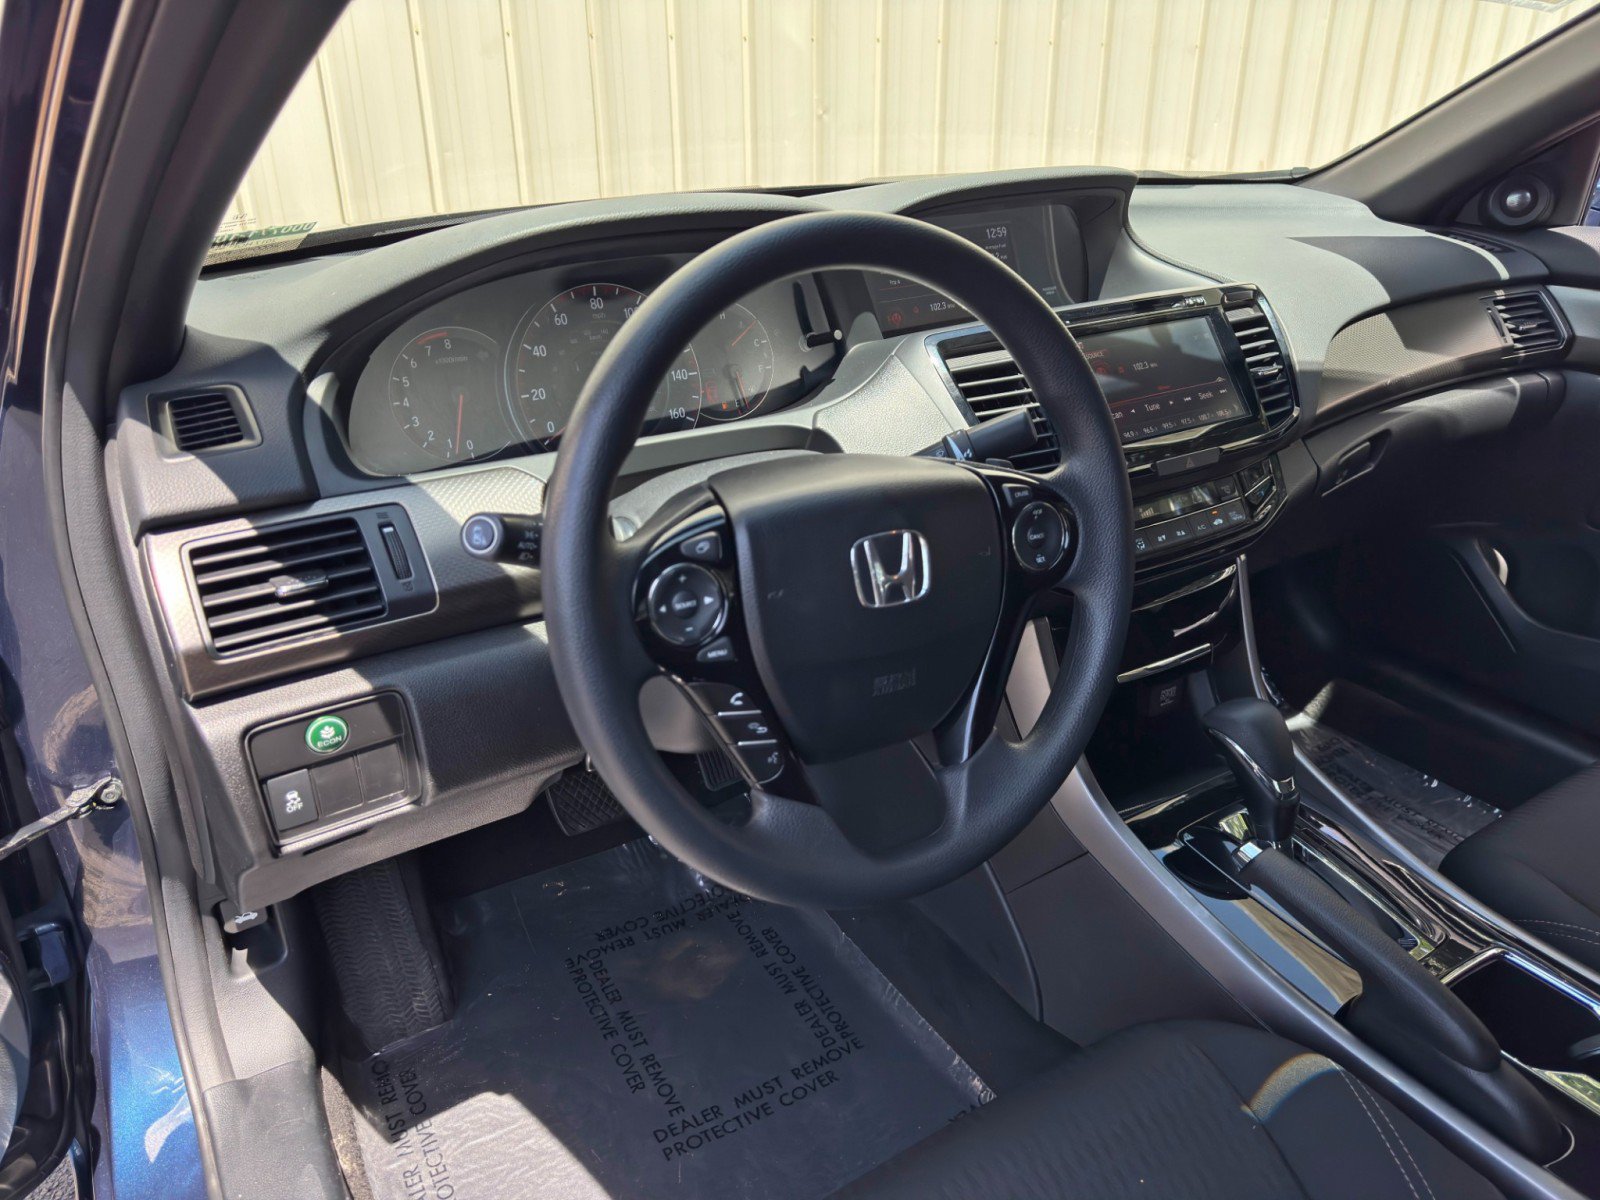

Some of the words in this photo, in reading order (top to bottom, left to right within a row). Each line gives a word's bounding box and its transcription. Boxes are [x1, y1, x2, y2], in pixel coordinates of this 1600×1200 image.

[986, 226, 1007, 239] 12:59
[589, 297, 604, 310] 80
[929, 301, 947, 312] 102.3
[623, 306, 638, 319] 10
[554, 313, 568, 326] 60
[444, 338, 452, 349] 8
[753, 338, 760, 347] C
[425, 345, 432, 357] 7
[532, 344, 547, 357] 40
[410, 358, 418, 369] 6
[1132, 361, 1150, 371] 102.3
[671, 368, 688, 382] 140
[402, 376, 410, 388] 5
[531, 388, 546, 401] 20
[1144, 403, 1161, 412] Tune
[1198, 390, 1214, 401] Seek
[402, 396, 410, 408] 4
[668, 407, 686, 420] 160
[411, 416, 420, 428] 3
[547, 421, 554, 433] 0
[427, 430, 436, 441] 2
[447, 438, 453, 449] 1
[466, 440, 474, 450] 0
[706, 648, 728, 658] MENU
[317, 735, 343, 748] ECON
[286, 801, 303, 814] OFF
[594, 916, 650, 942] COVER
[642, 917, 687, 942] MUST
[727, 912, 770, 959] REMOVE
[760, 926, 797, 965] COVER
[762, 962, 797, 996] MUST
[790, 965, 855, 1041] PROTECTIVE
[568, 965, 620, 1041] PROTECTIVE
[610, 1042, 646, 1094] COVER
[794, 999, 837, 1049] DEALER
[588, 959, 624, 1006] DEALER
[616, 1009, 650, 1049] MUST
[639, 1053, 686, 1118] REMOVE
[398, 1066, 428, 1116] COVER
[652, 1104, 724, 1144] DEALER
[734, 1076, 785, 1110] MUST
[790, 1037, 866, 1081] REMOVE
[662, 1102, 775, 1162] PROTECTIVE
[778, 1069, 841, 1108] COVER
[384, 1112, 415, 1158] MUST
[414, 1118, 456, 1200] OTECTIVE
